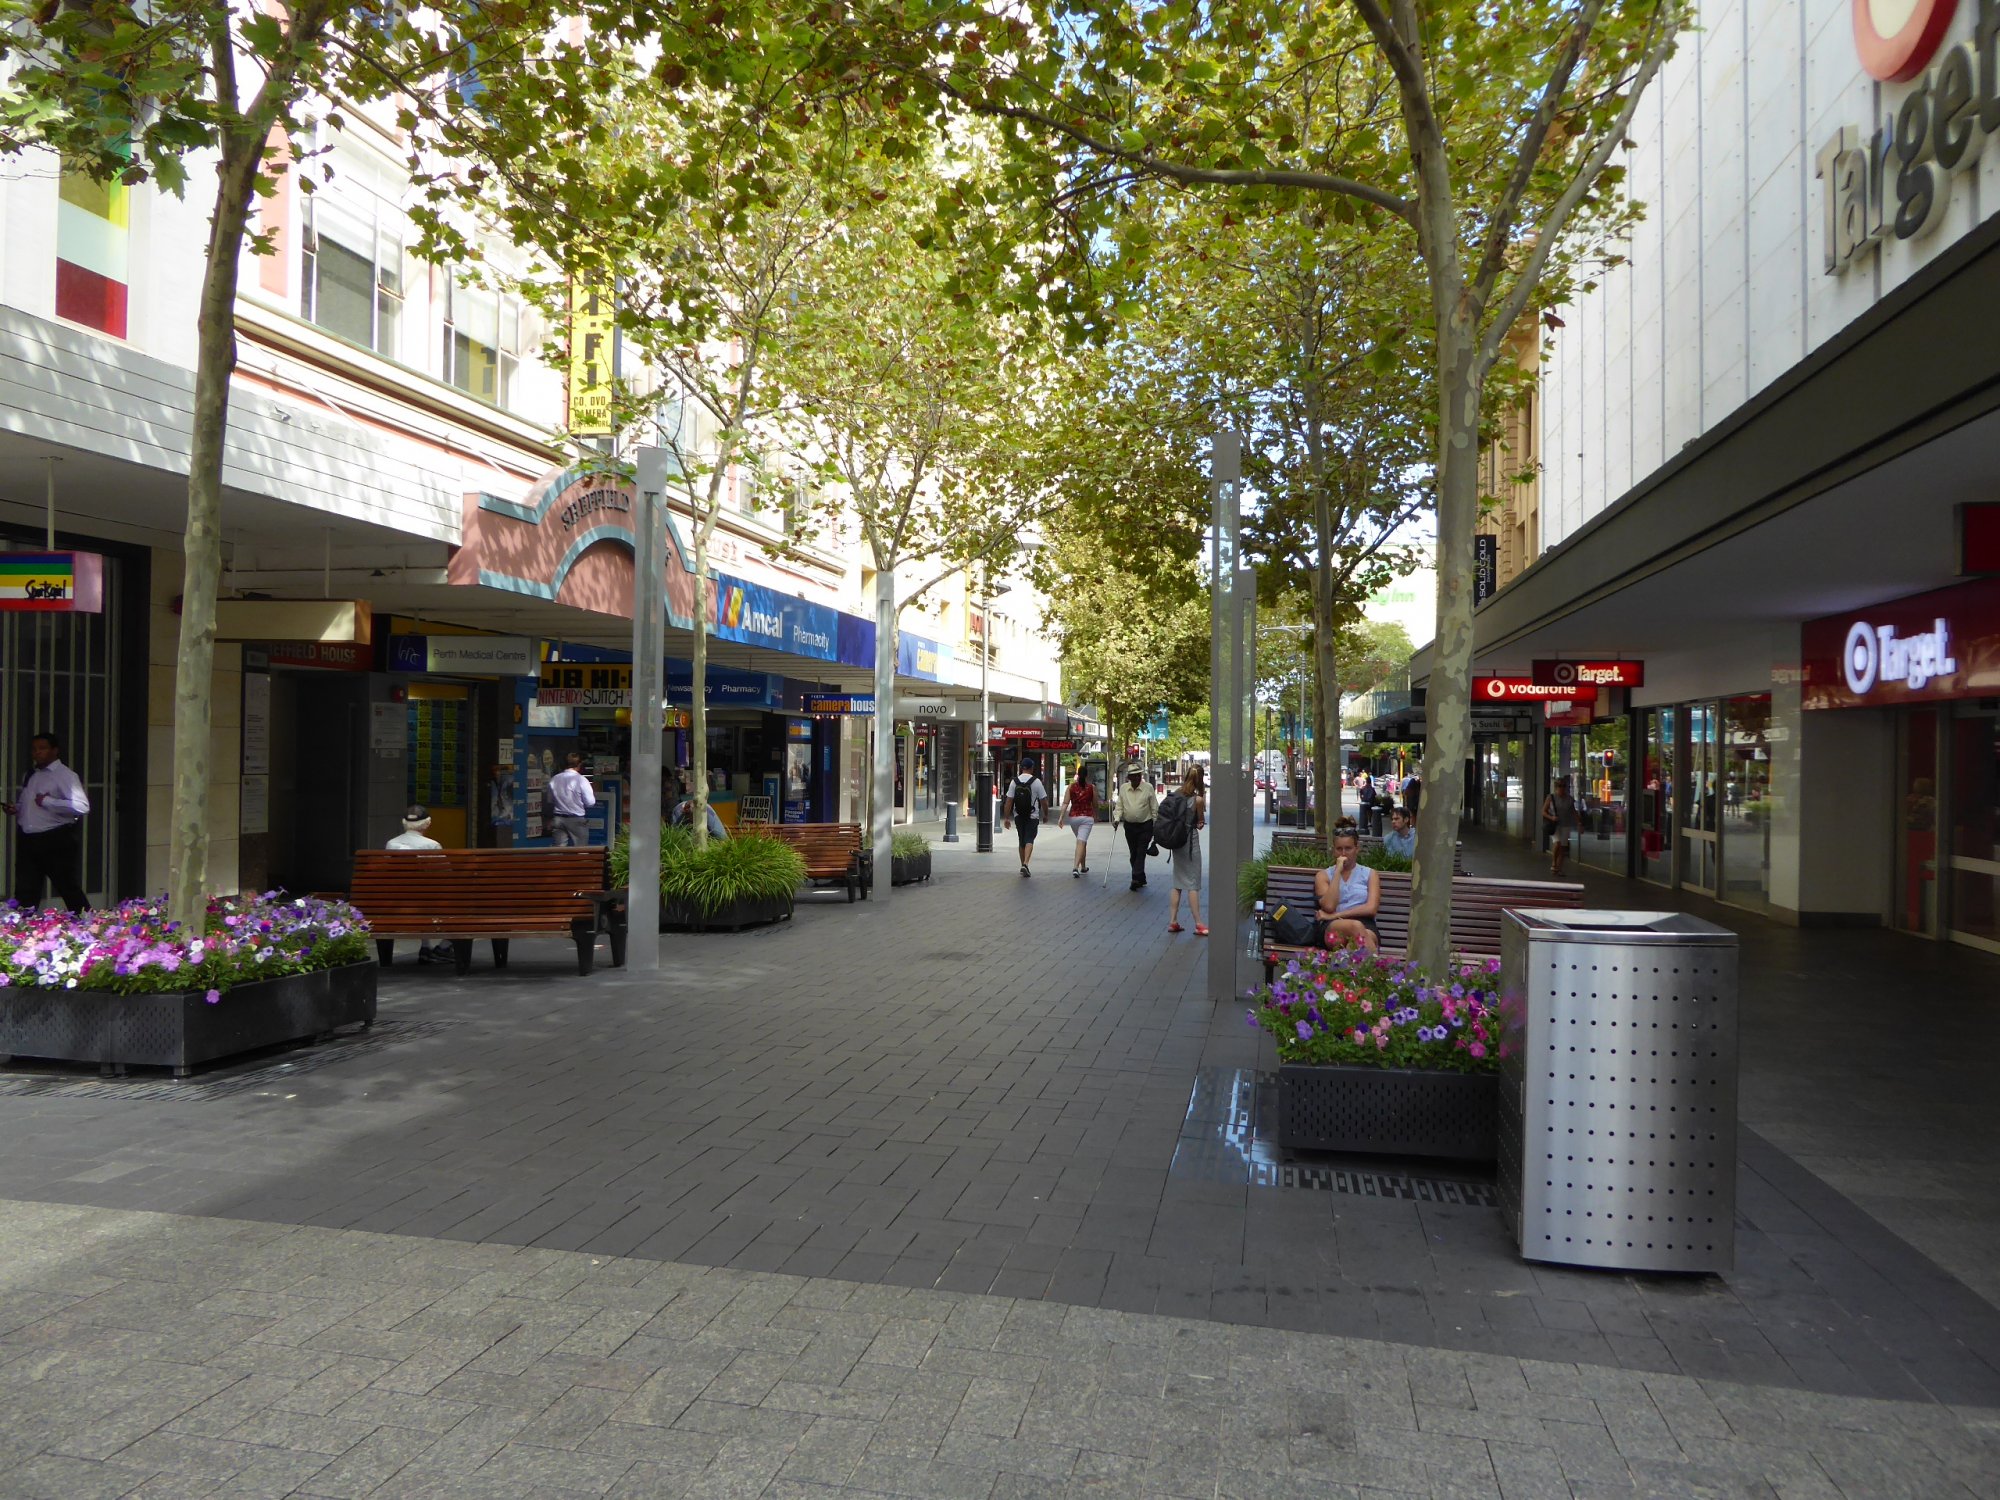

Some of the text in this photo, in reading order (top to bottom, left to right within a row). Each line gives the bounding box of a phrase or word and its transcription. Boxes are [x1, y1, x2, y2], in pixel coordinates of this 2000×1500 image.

[561, 489, 630, 532] SHEFFIELD
[741, 601, 783, 639] Amcal
[320, 646, 357, 664] HOUSE
[432, 649, 527, 661] Perth Medical Centre
[541, 669, 632, 689] JB HI-
[537, 688, 583, 705] NINTENDO
[583, 688, 624, 705] SWITCH
[721, 684, 762, 695] Pharmacy
[810, 697, 876, 712] camerahous
[919, 705, 947, 714] novo
[749, 797, 770, 808] HOUR
[741, 808, 769, 819] PHOTOS
